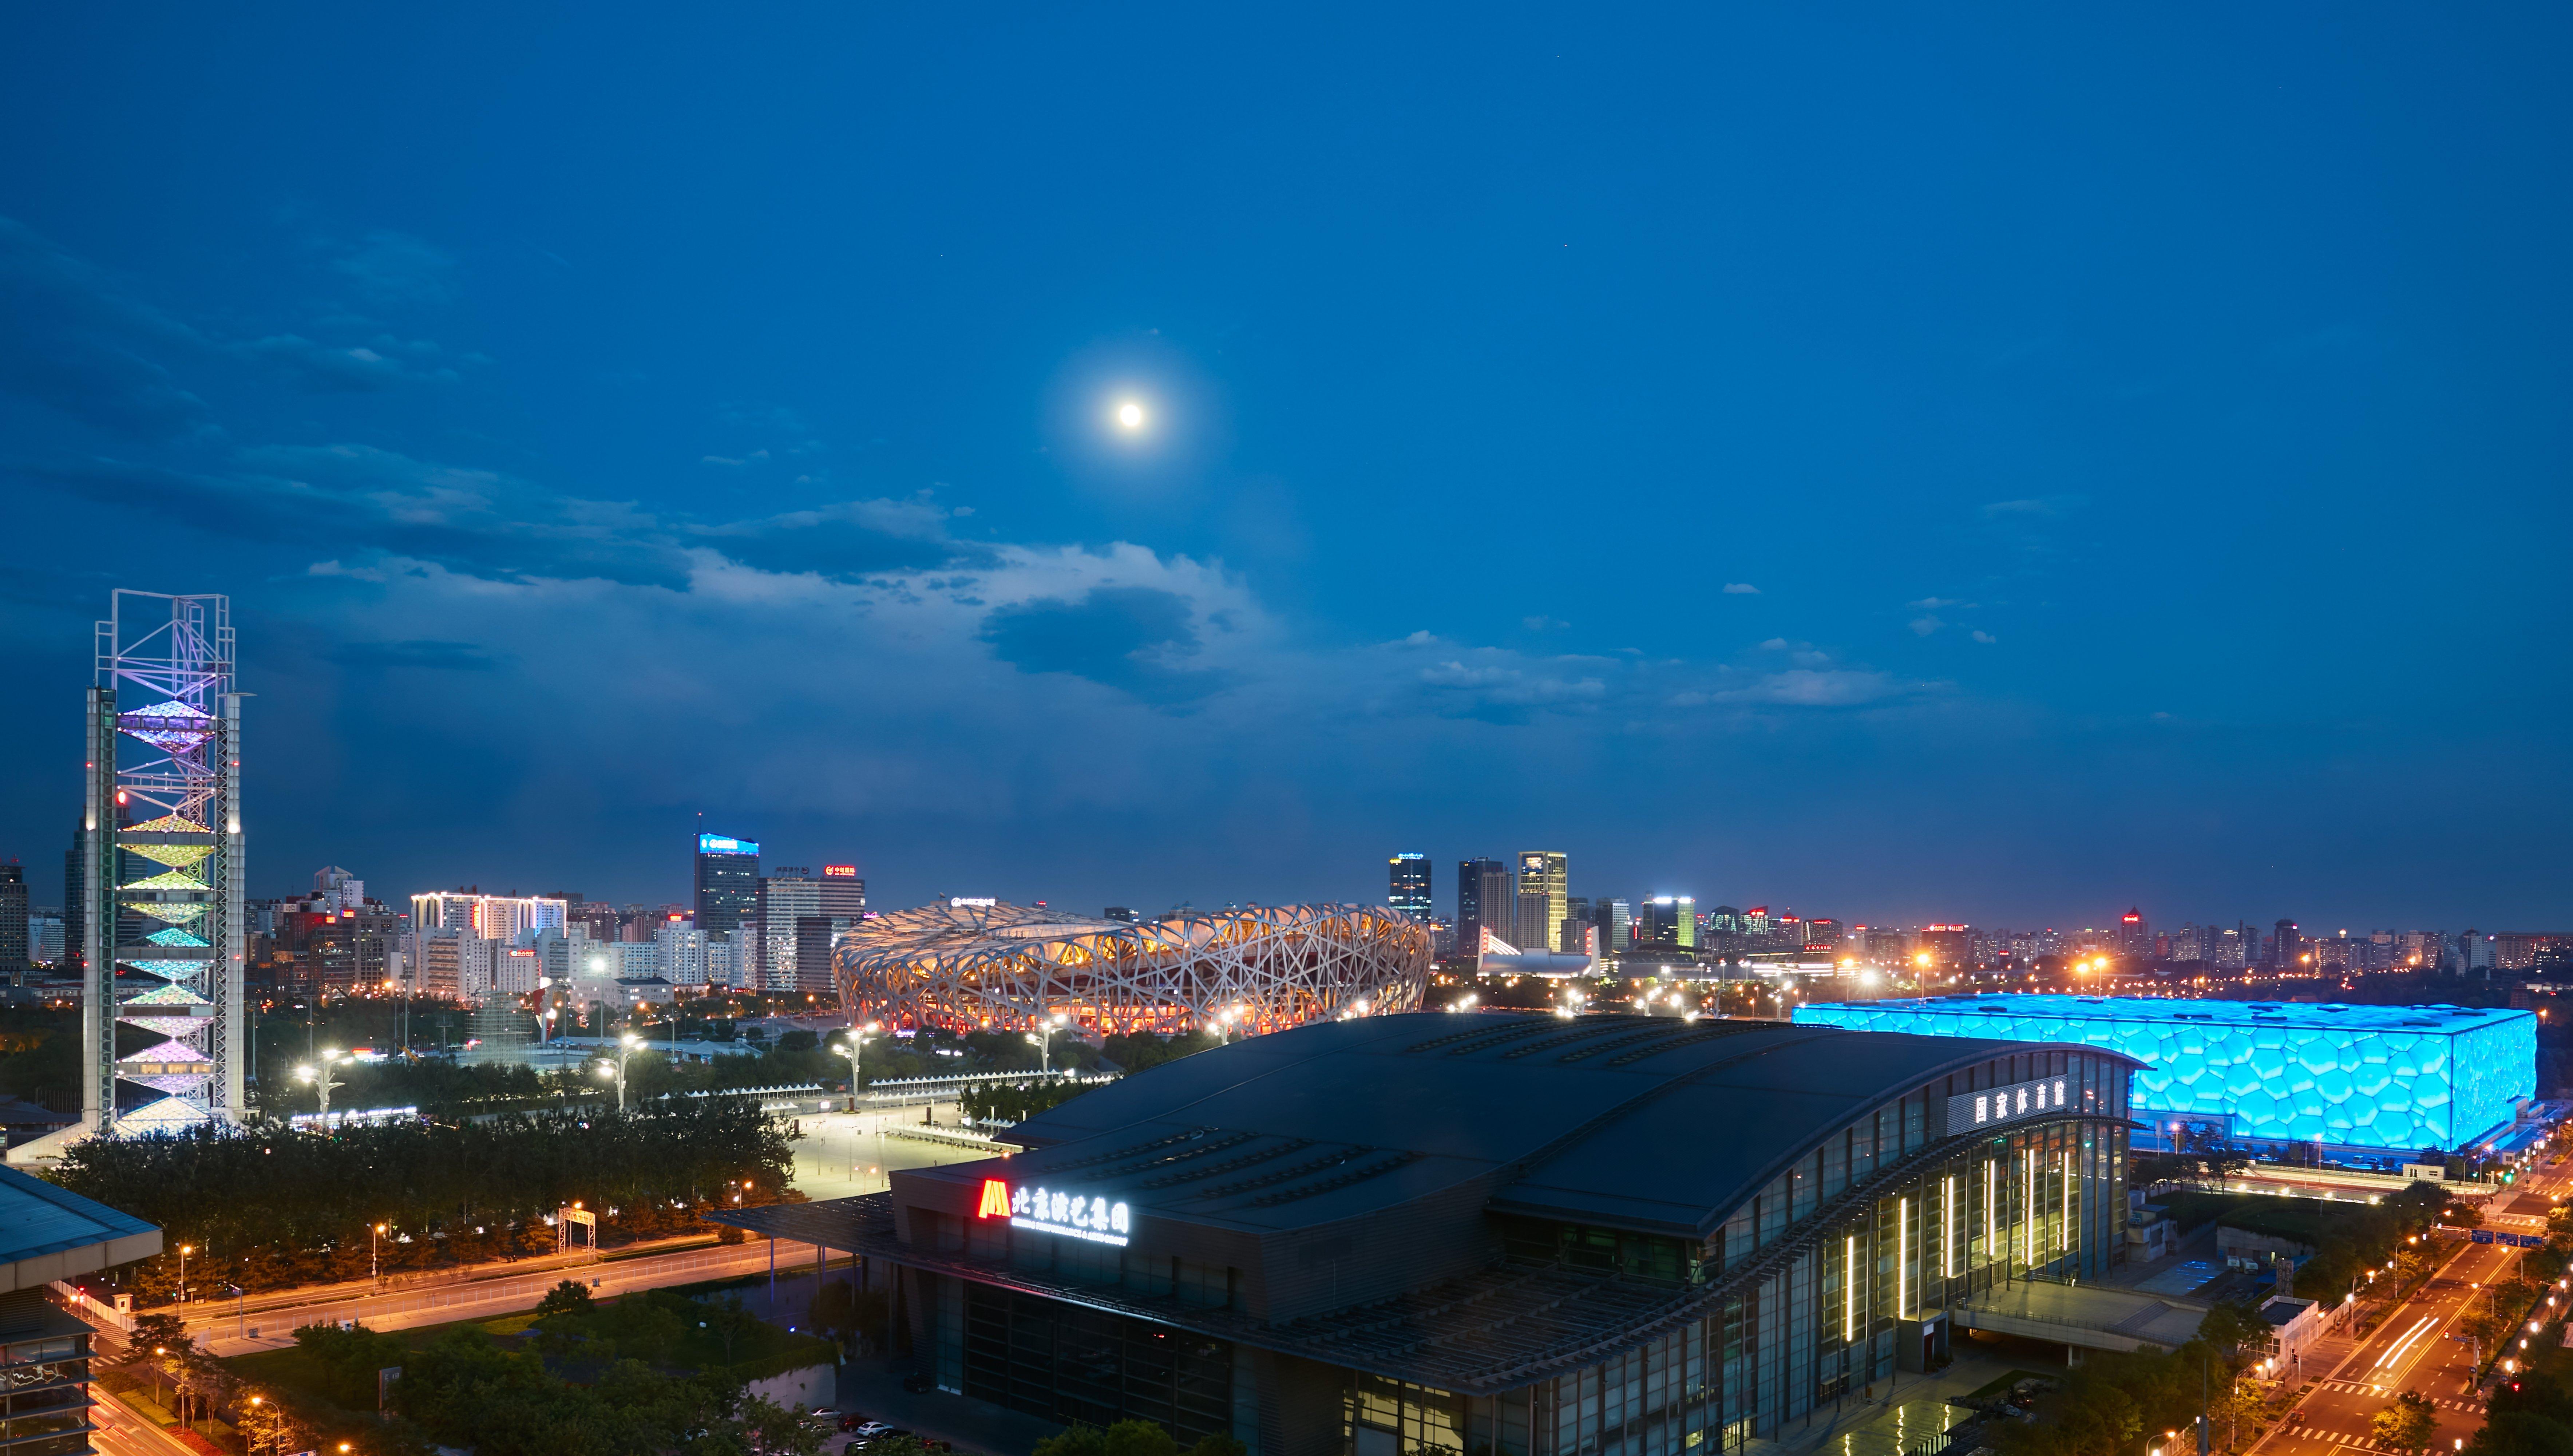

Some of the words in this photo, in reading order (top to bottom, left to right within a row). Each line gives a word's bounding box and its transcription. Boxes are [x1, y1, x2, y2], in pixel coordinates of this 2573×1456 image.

[1976, 1081, 2064, 1123] 国家体育馆
[1012, 1188, 1128, 1233] 北京演艺集团
